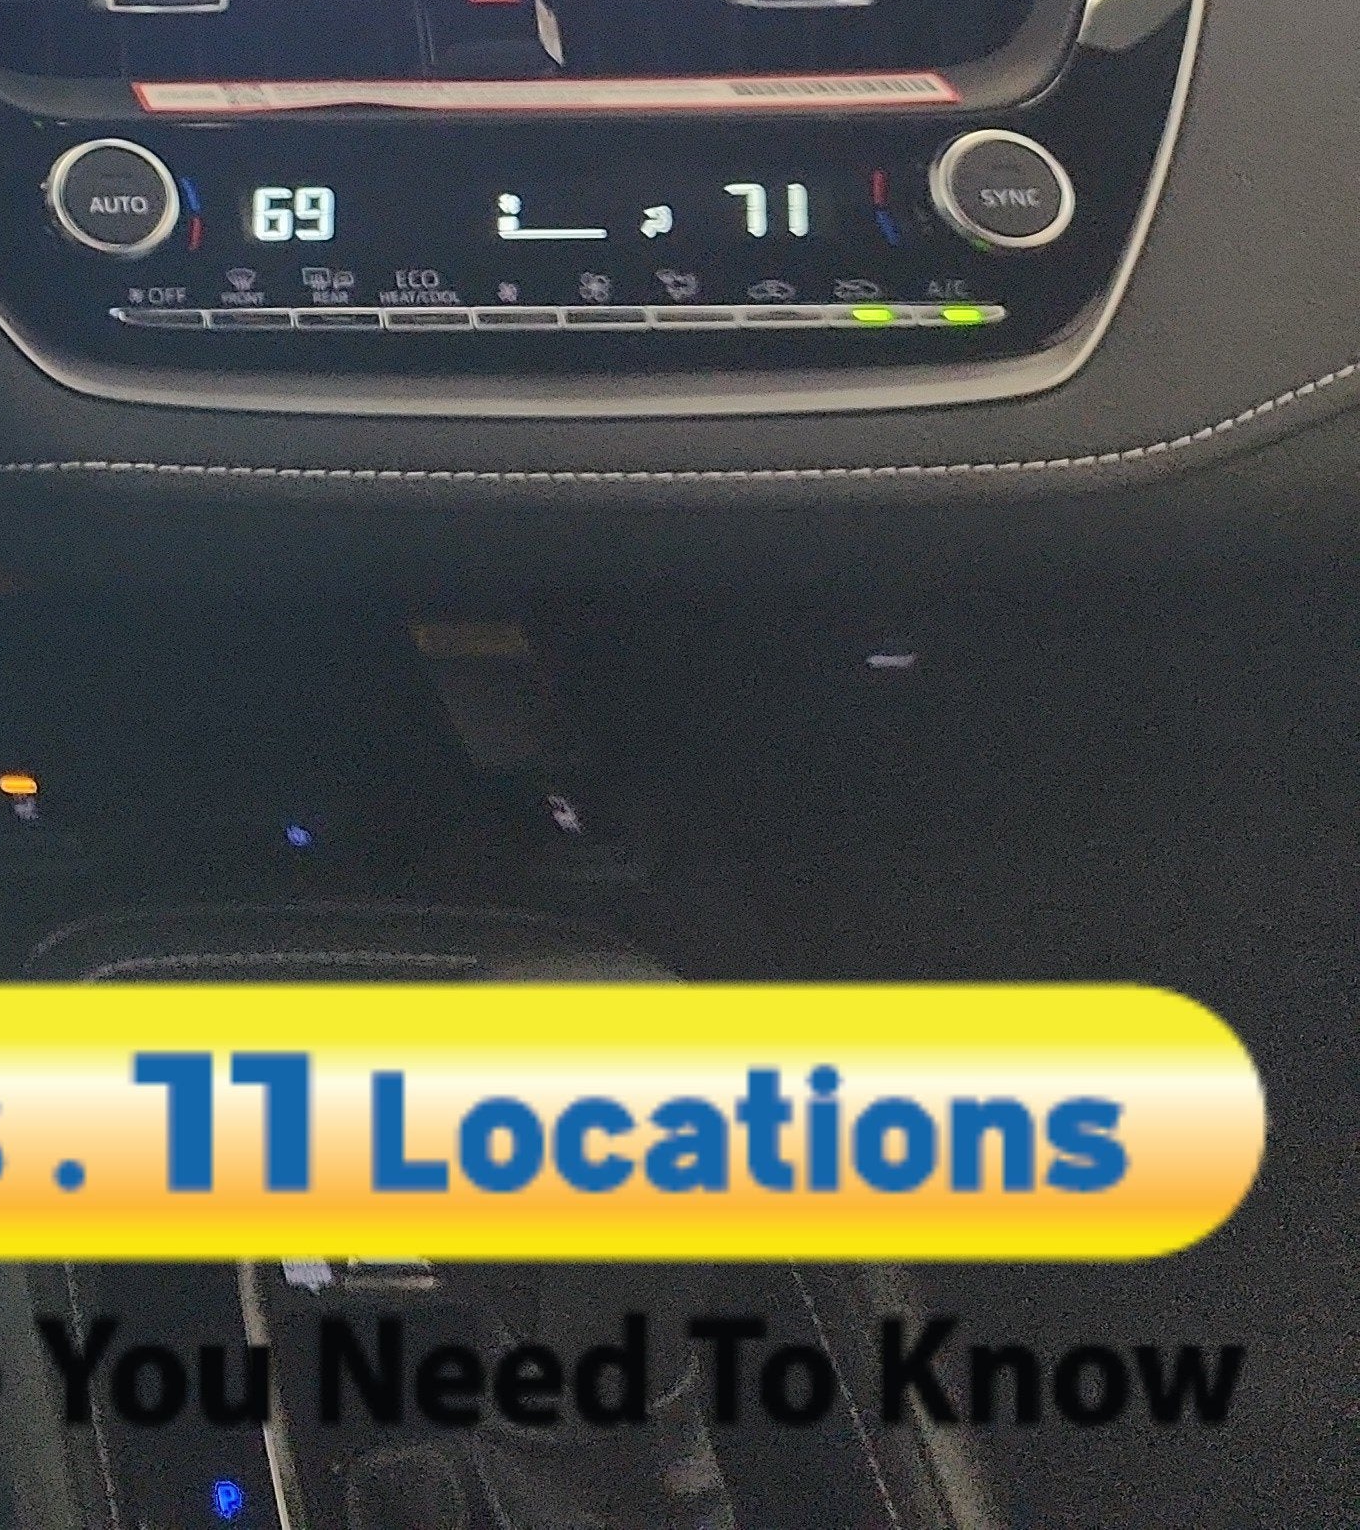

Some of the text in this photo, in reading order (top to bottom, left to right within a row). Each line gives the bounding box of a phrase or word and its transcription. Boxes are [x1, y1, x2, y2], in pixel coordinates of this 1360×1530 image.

[89, 194, 148, 215] AUTO
[981, 186, 1041, 207] SYNC
[252, 186, 335, 242] 69
[724, 182, 810, 238] 71
[395, 269, 440, 289] ECO
[927, 278, 968, 296] A/C
[148, 287, 187, 304] OFF
[220, 290, 266, 306] FRONT
[312, 290, 349, 305] REAR
